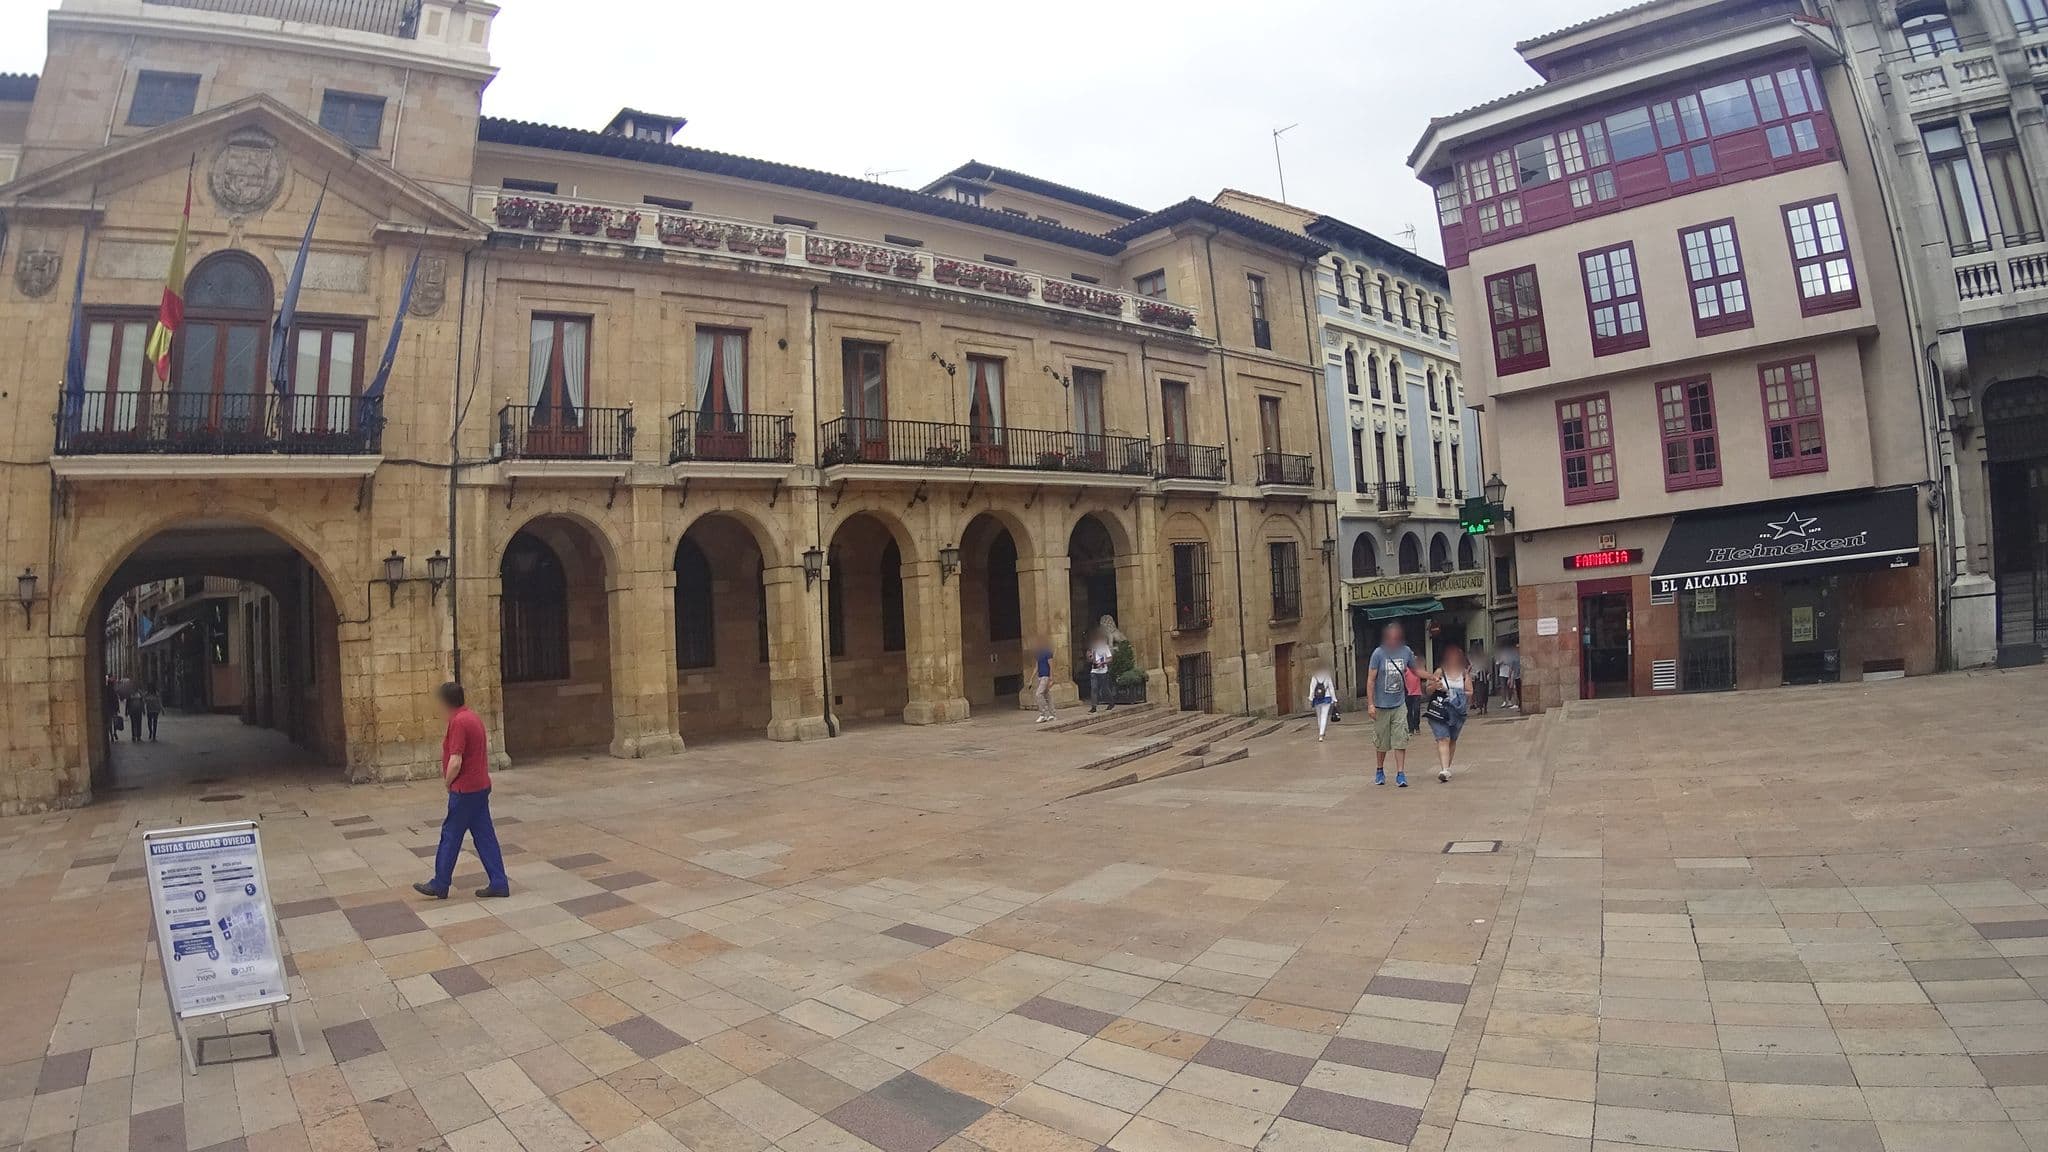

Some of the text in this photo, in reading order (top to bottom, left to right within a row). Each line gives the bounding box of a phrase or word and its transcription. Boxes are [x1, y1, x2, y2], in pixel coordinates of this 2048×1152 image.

[1706, 534, 1866, 563] Heineken
[1575, 550, 1628, 568] FARMACIA
[1661, 572, 1748, 592] EL ALCALDE
[152, 835, 251, 854] VISITAS GUIADAS OVIEDO
